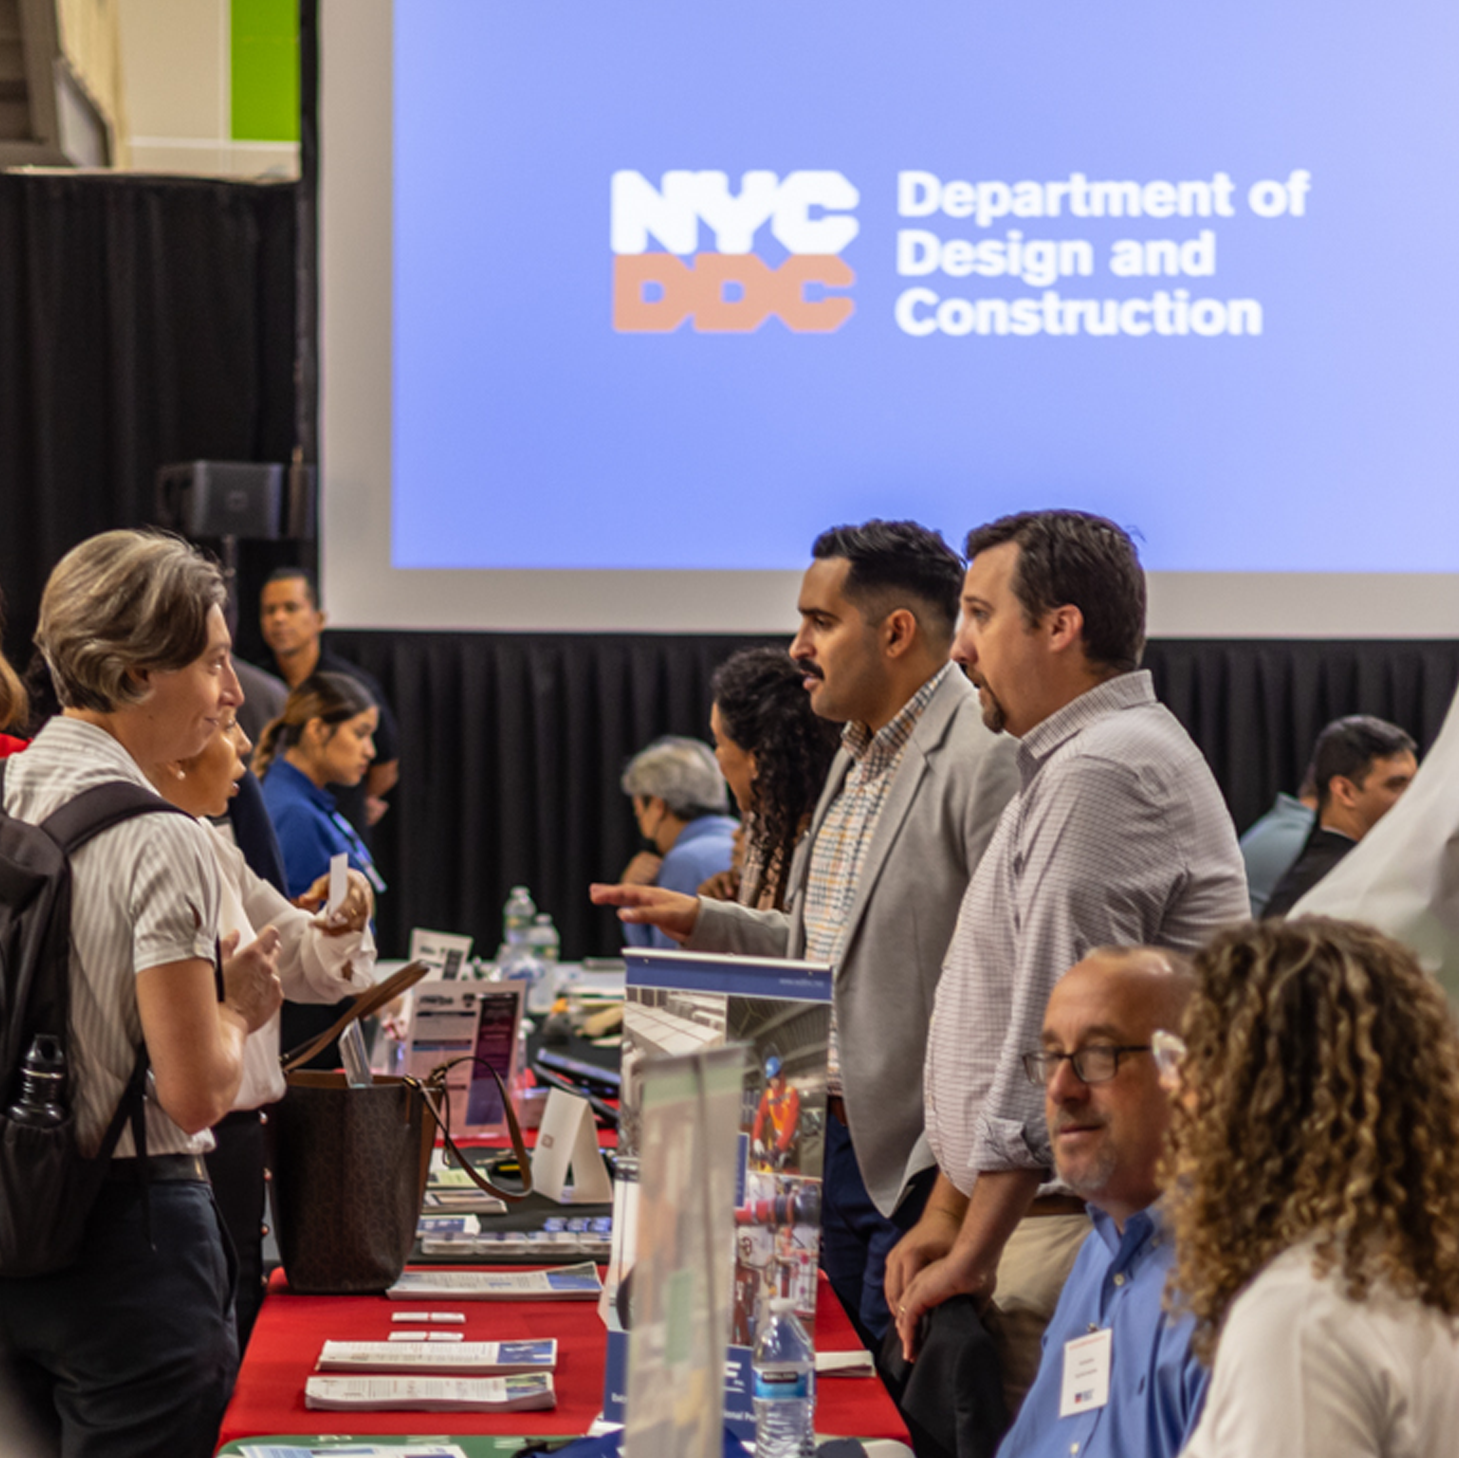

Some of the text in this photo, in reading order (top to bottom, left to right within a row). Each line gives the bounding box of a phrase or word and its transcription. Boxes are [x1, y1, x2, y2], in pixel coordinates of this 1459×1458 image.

[611, 170, 859, 254] NYC
[897, 170, 1311, 226] Department of
[897, 230, 1216, 286] Design and
[613, 253, 855, 332] DDC
[895, 287, 1263, 336] Construction
